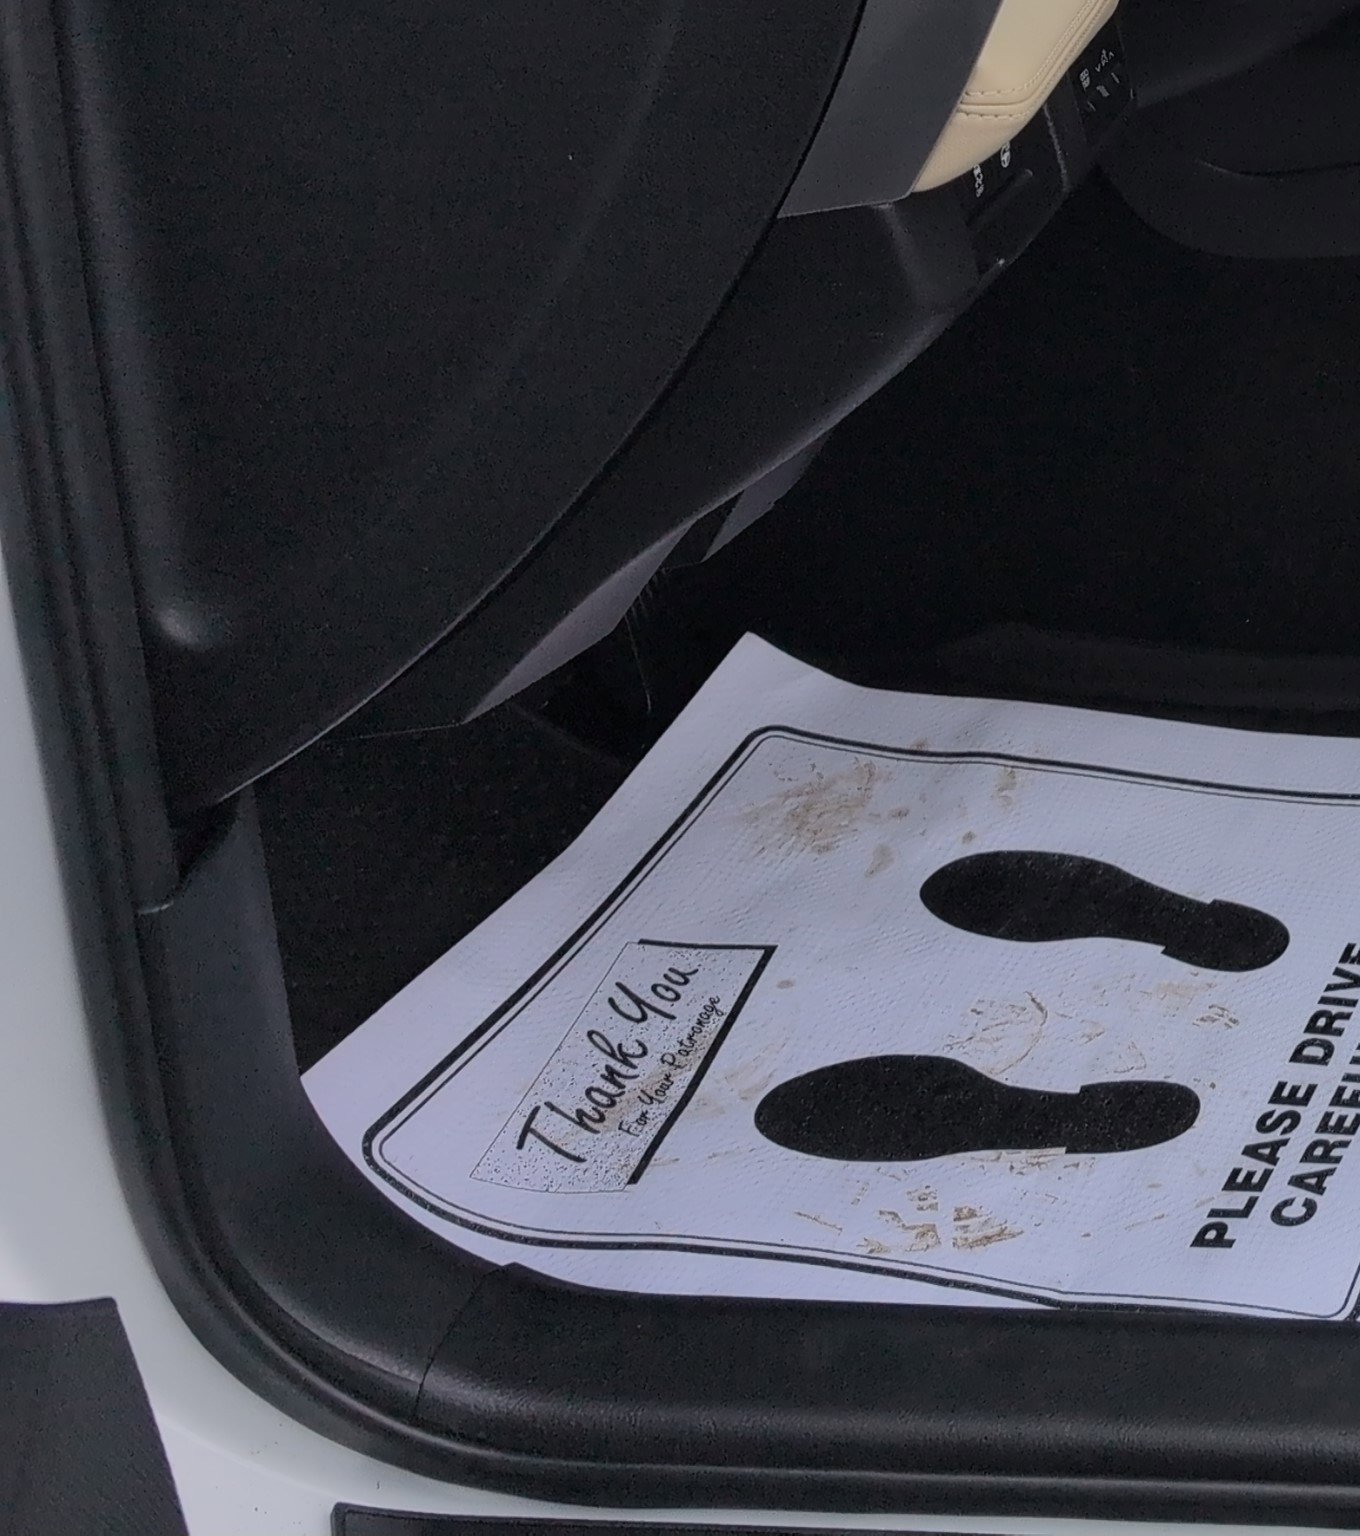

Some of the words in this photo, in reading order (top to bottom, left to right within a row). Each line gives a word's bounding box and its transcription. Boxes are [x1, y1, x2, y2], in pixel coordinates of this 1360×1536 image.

[516, 1028, 649, 1164] Thank
[607, 963, 699, 1023] You
[617, 1108, 652, 1138] For
[637, 1072, 674, 1106] Your
[659, 993, 722, 1072] Patronage
[1190, 1080, 1318, 1249] PLEASE
